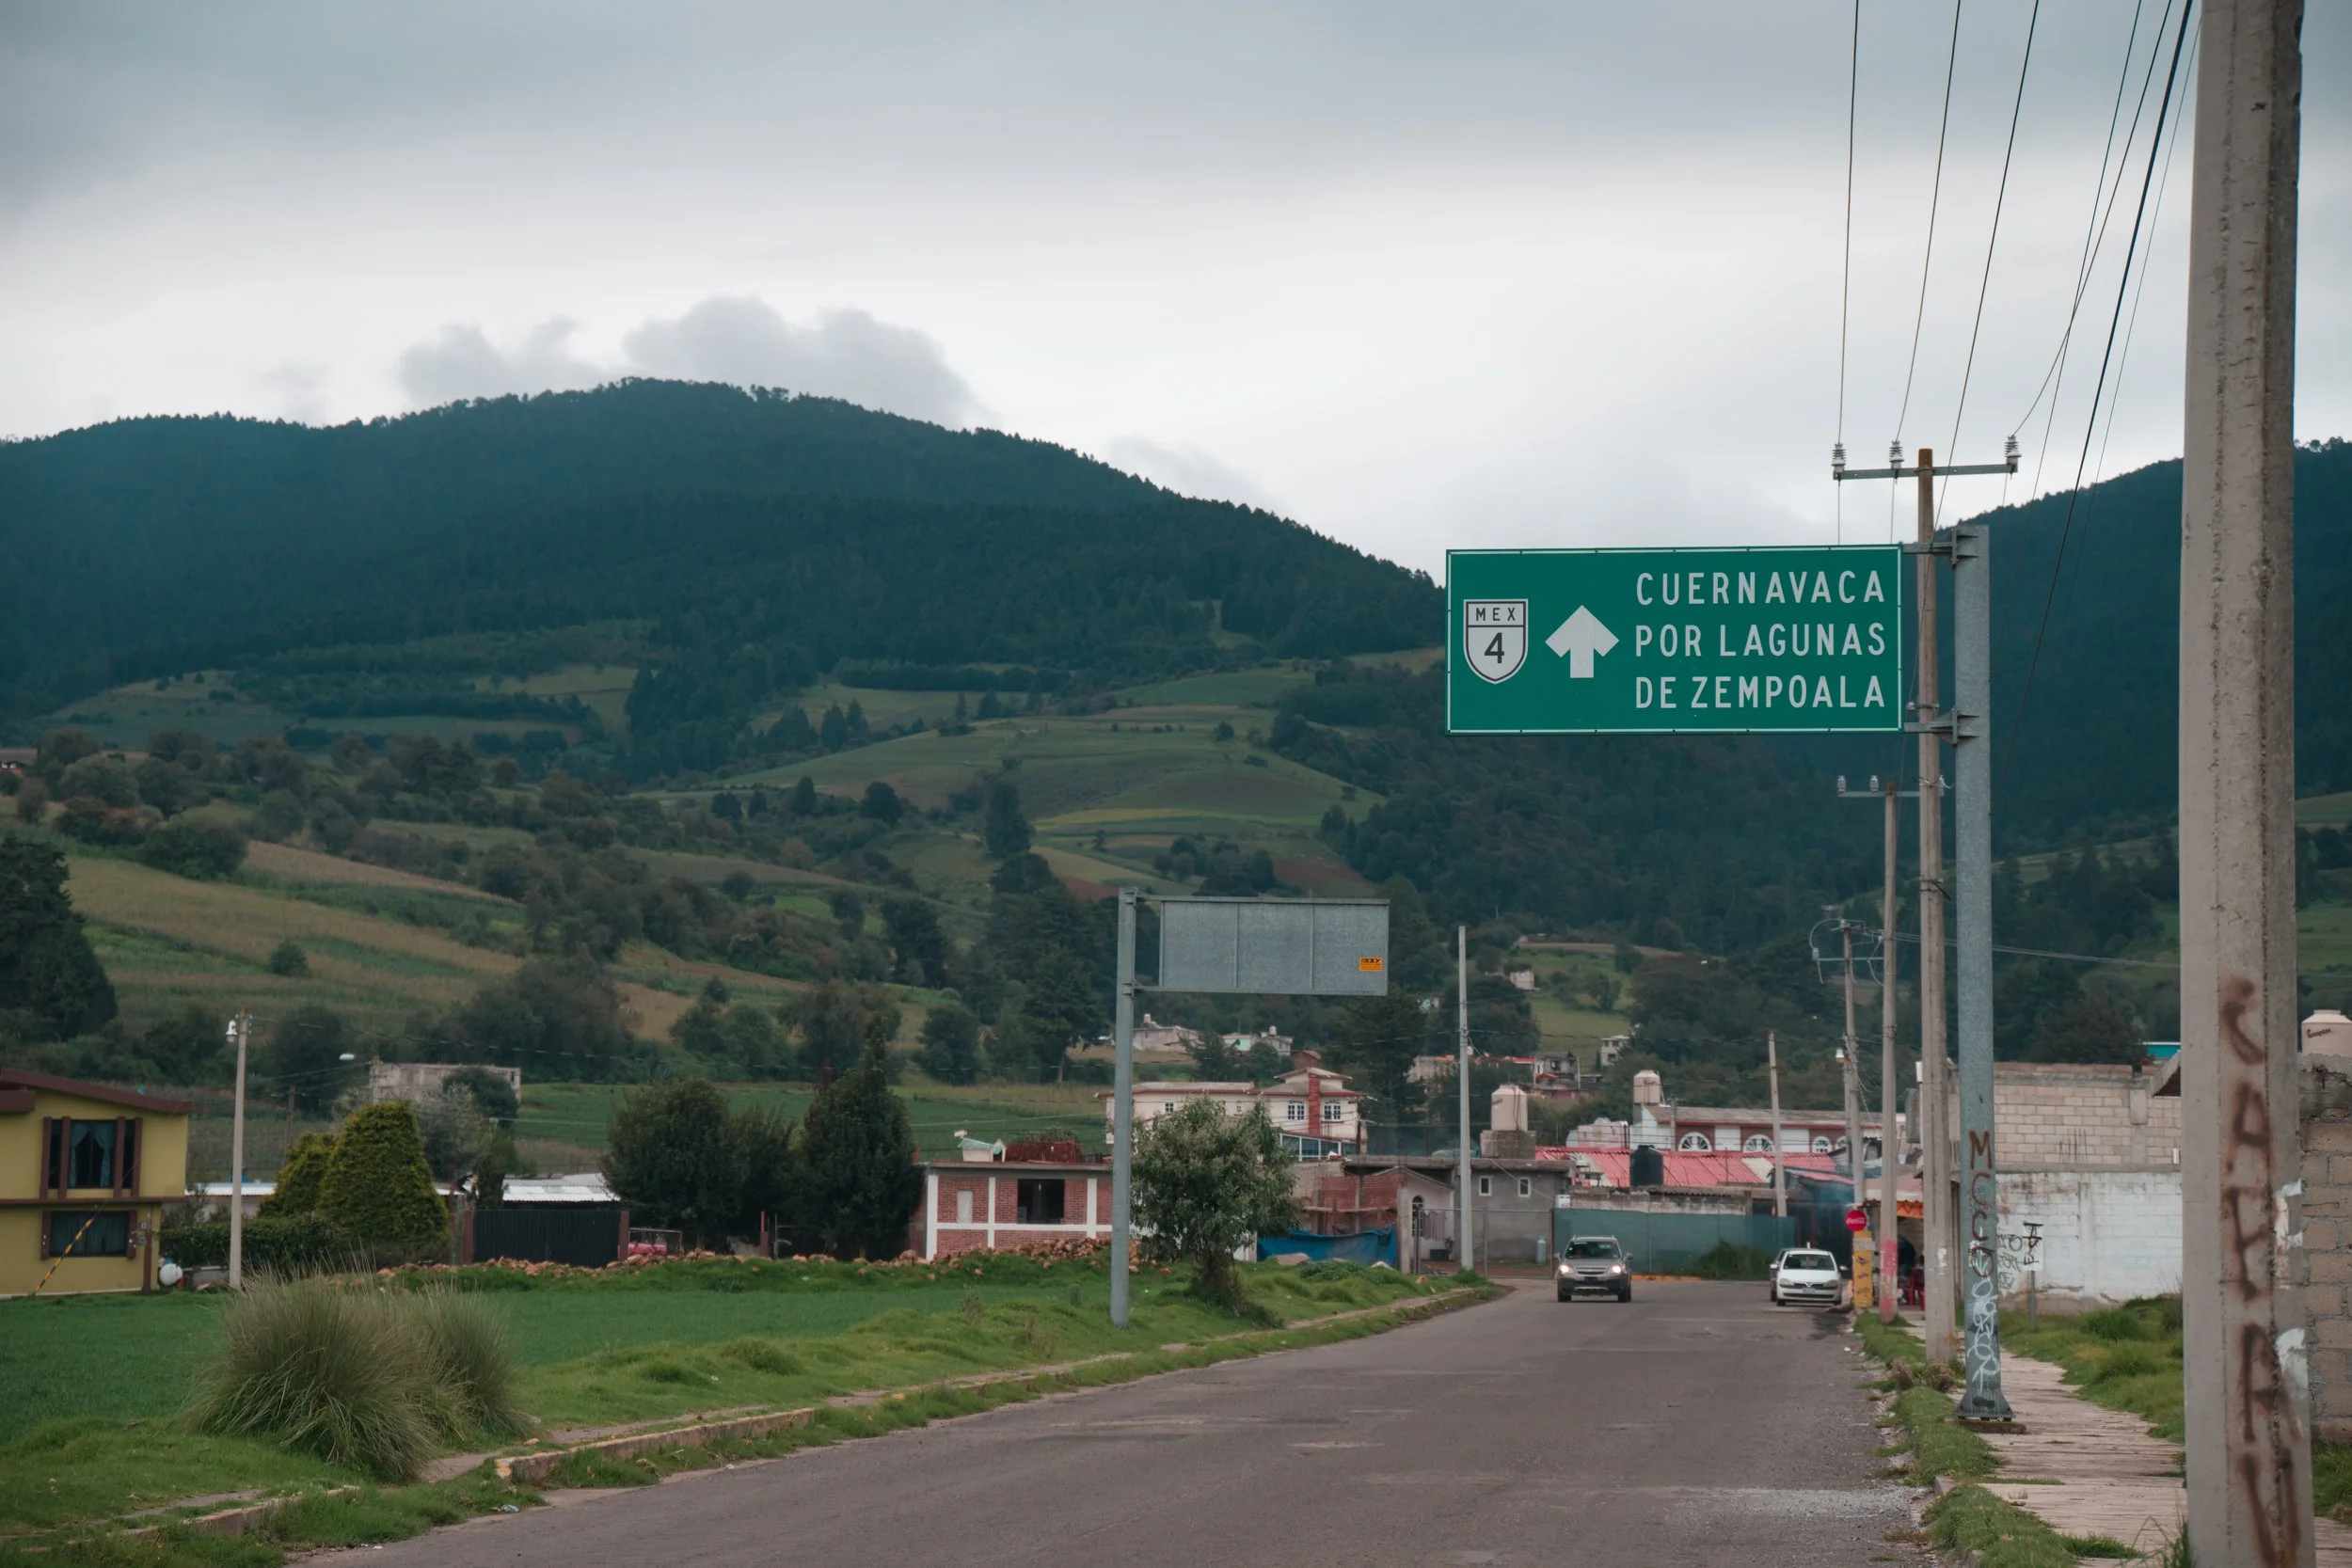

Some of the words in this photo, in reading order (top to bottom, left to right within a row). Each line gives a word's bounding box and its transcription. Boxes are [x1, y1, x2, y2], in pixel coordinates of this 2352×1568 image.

[1636, 570, 1884, 605] CUERNAVACA
[1475, 607, 1517, 622] MEX
[1484, 631, 1506, 665] 4
[1635, 624, 1702, 657] POR
[1720, 622, 1885, 657] LAGUNAS
[1635, 676, 1677, 709] DE
[1691, 674, 1884, 709] ZEMPOALA
